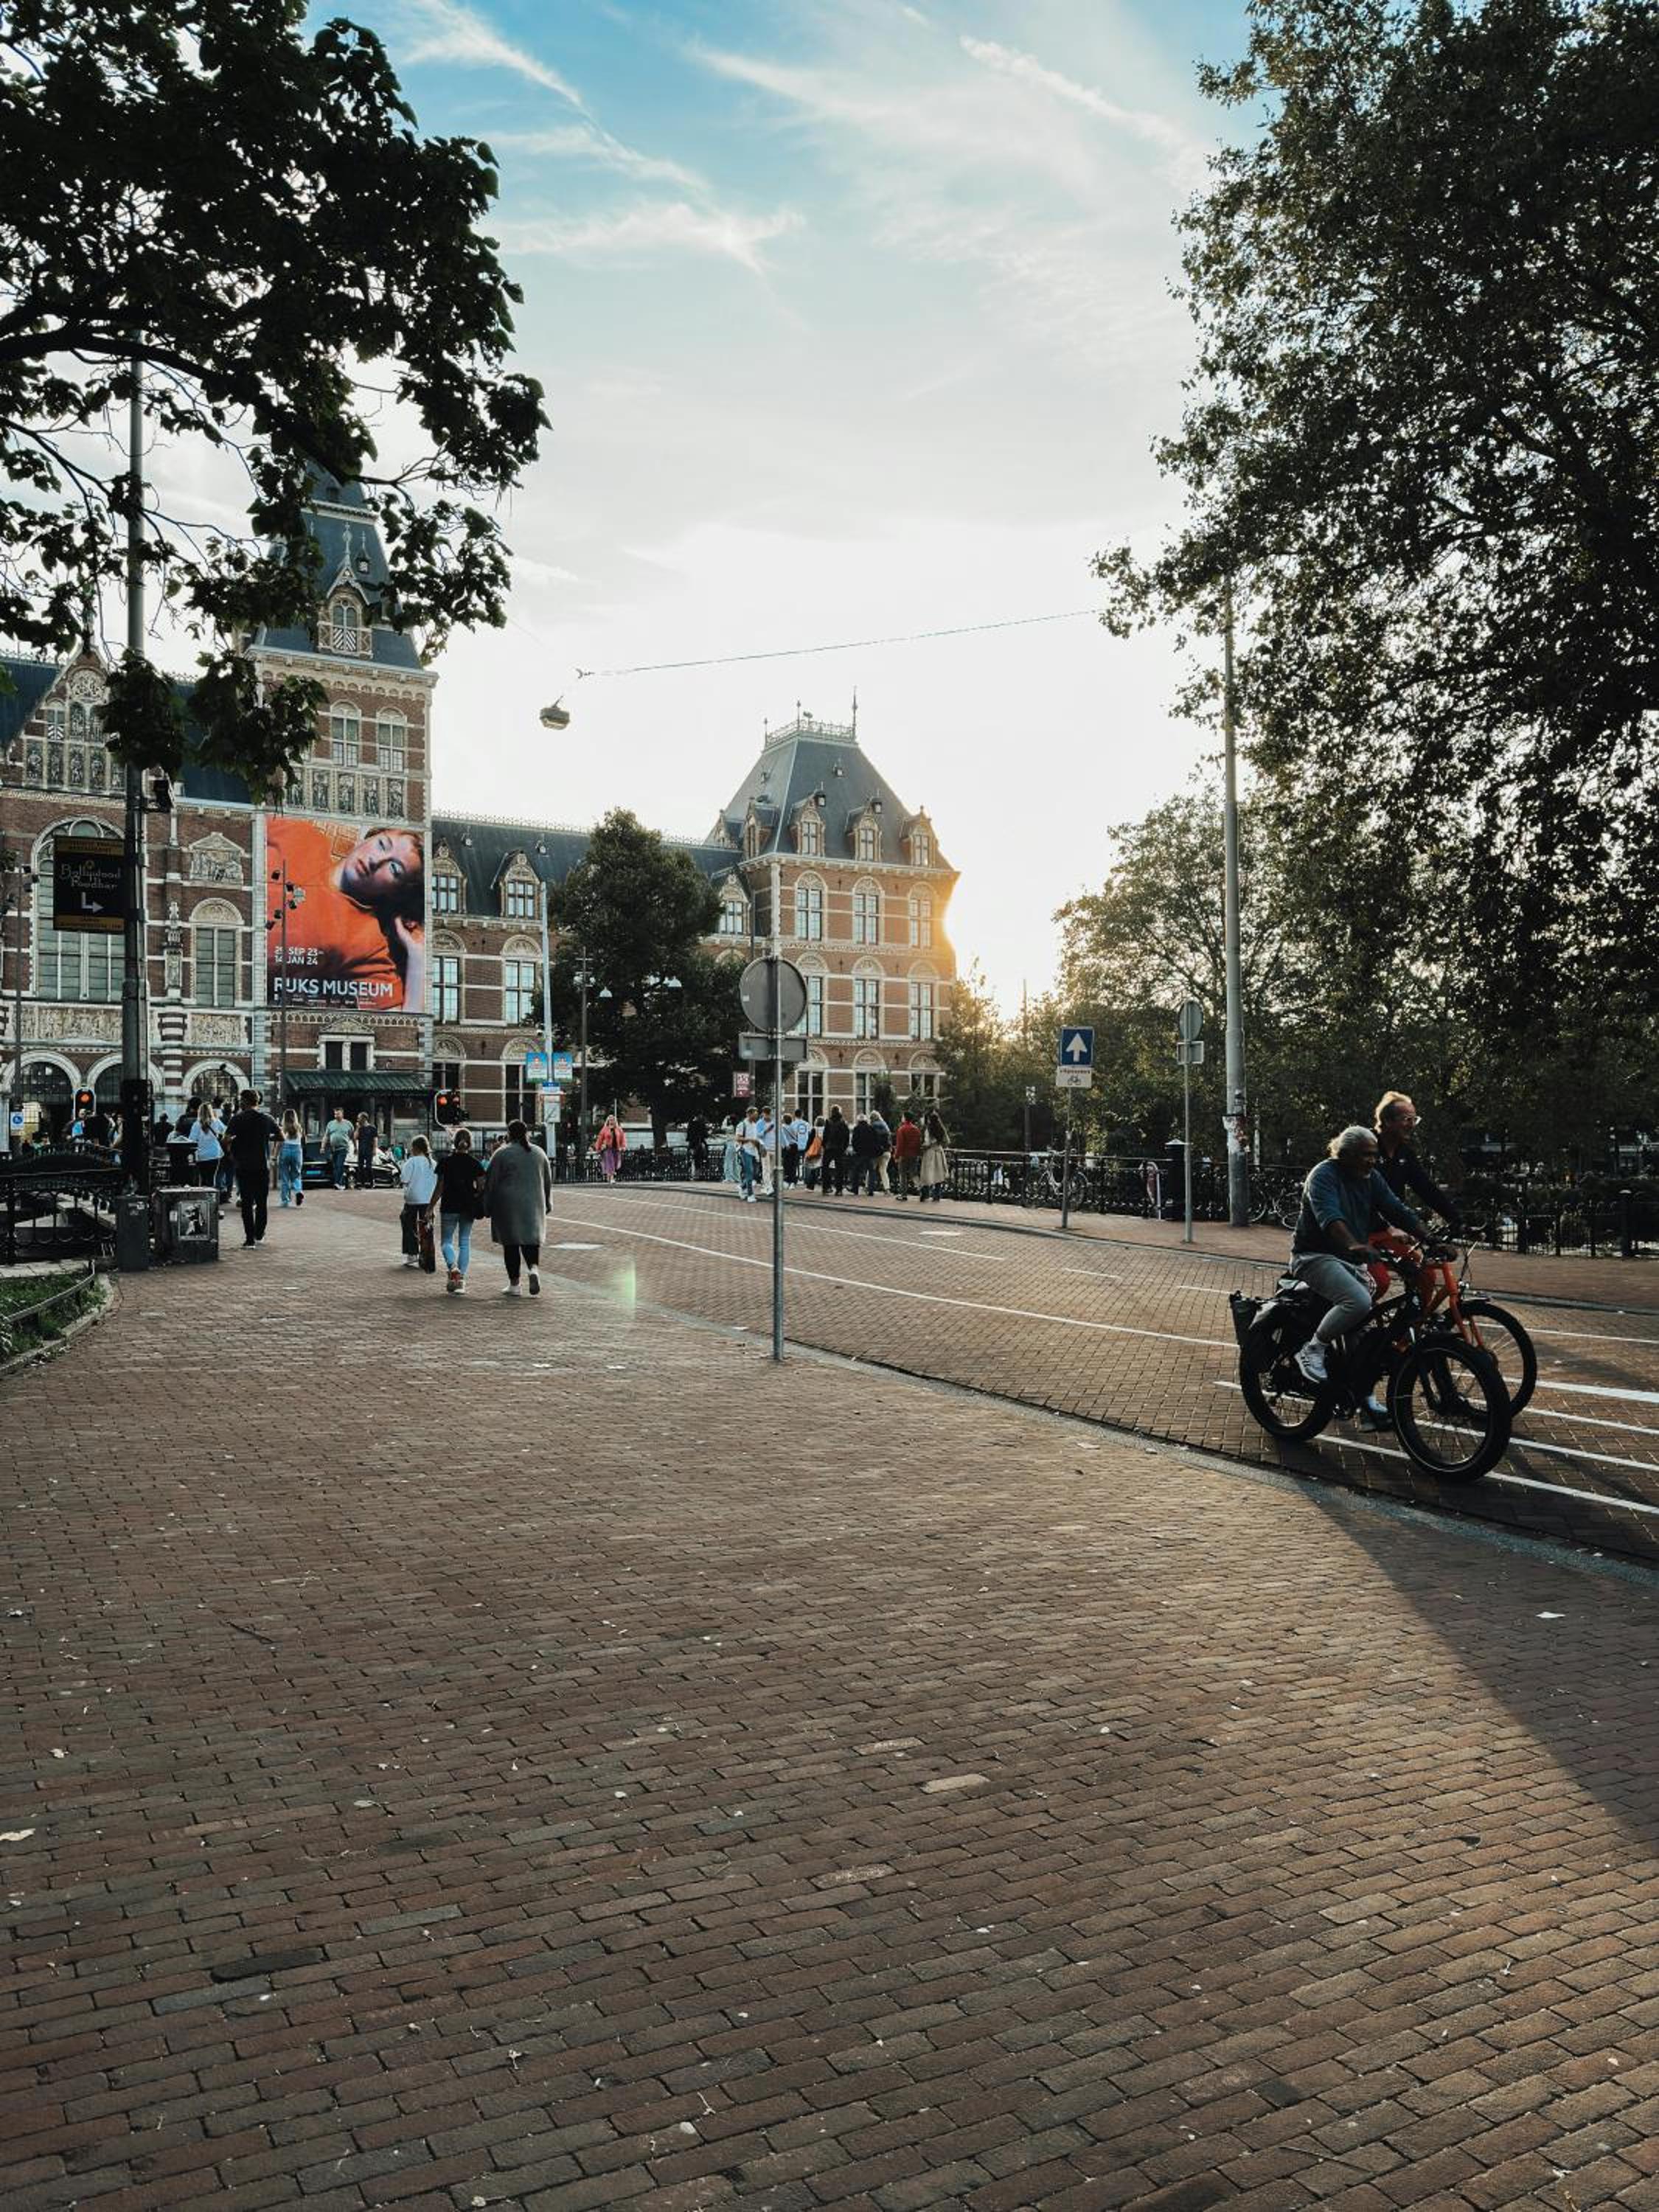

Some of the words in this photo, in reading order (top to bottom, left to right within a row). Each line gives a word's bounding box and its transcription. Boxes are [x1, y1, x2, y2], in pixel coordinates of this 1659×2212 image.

[288, 946, 305, 956] SEP
[286, 956, 305, 964] JAN
[307, 956, 319, 965] 24
[323, 980, 393, 998] MUSEUM
